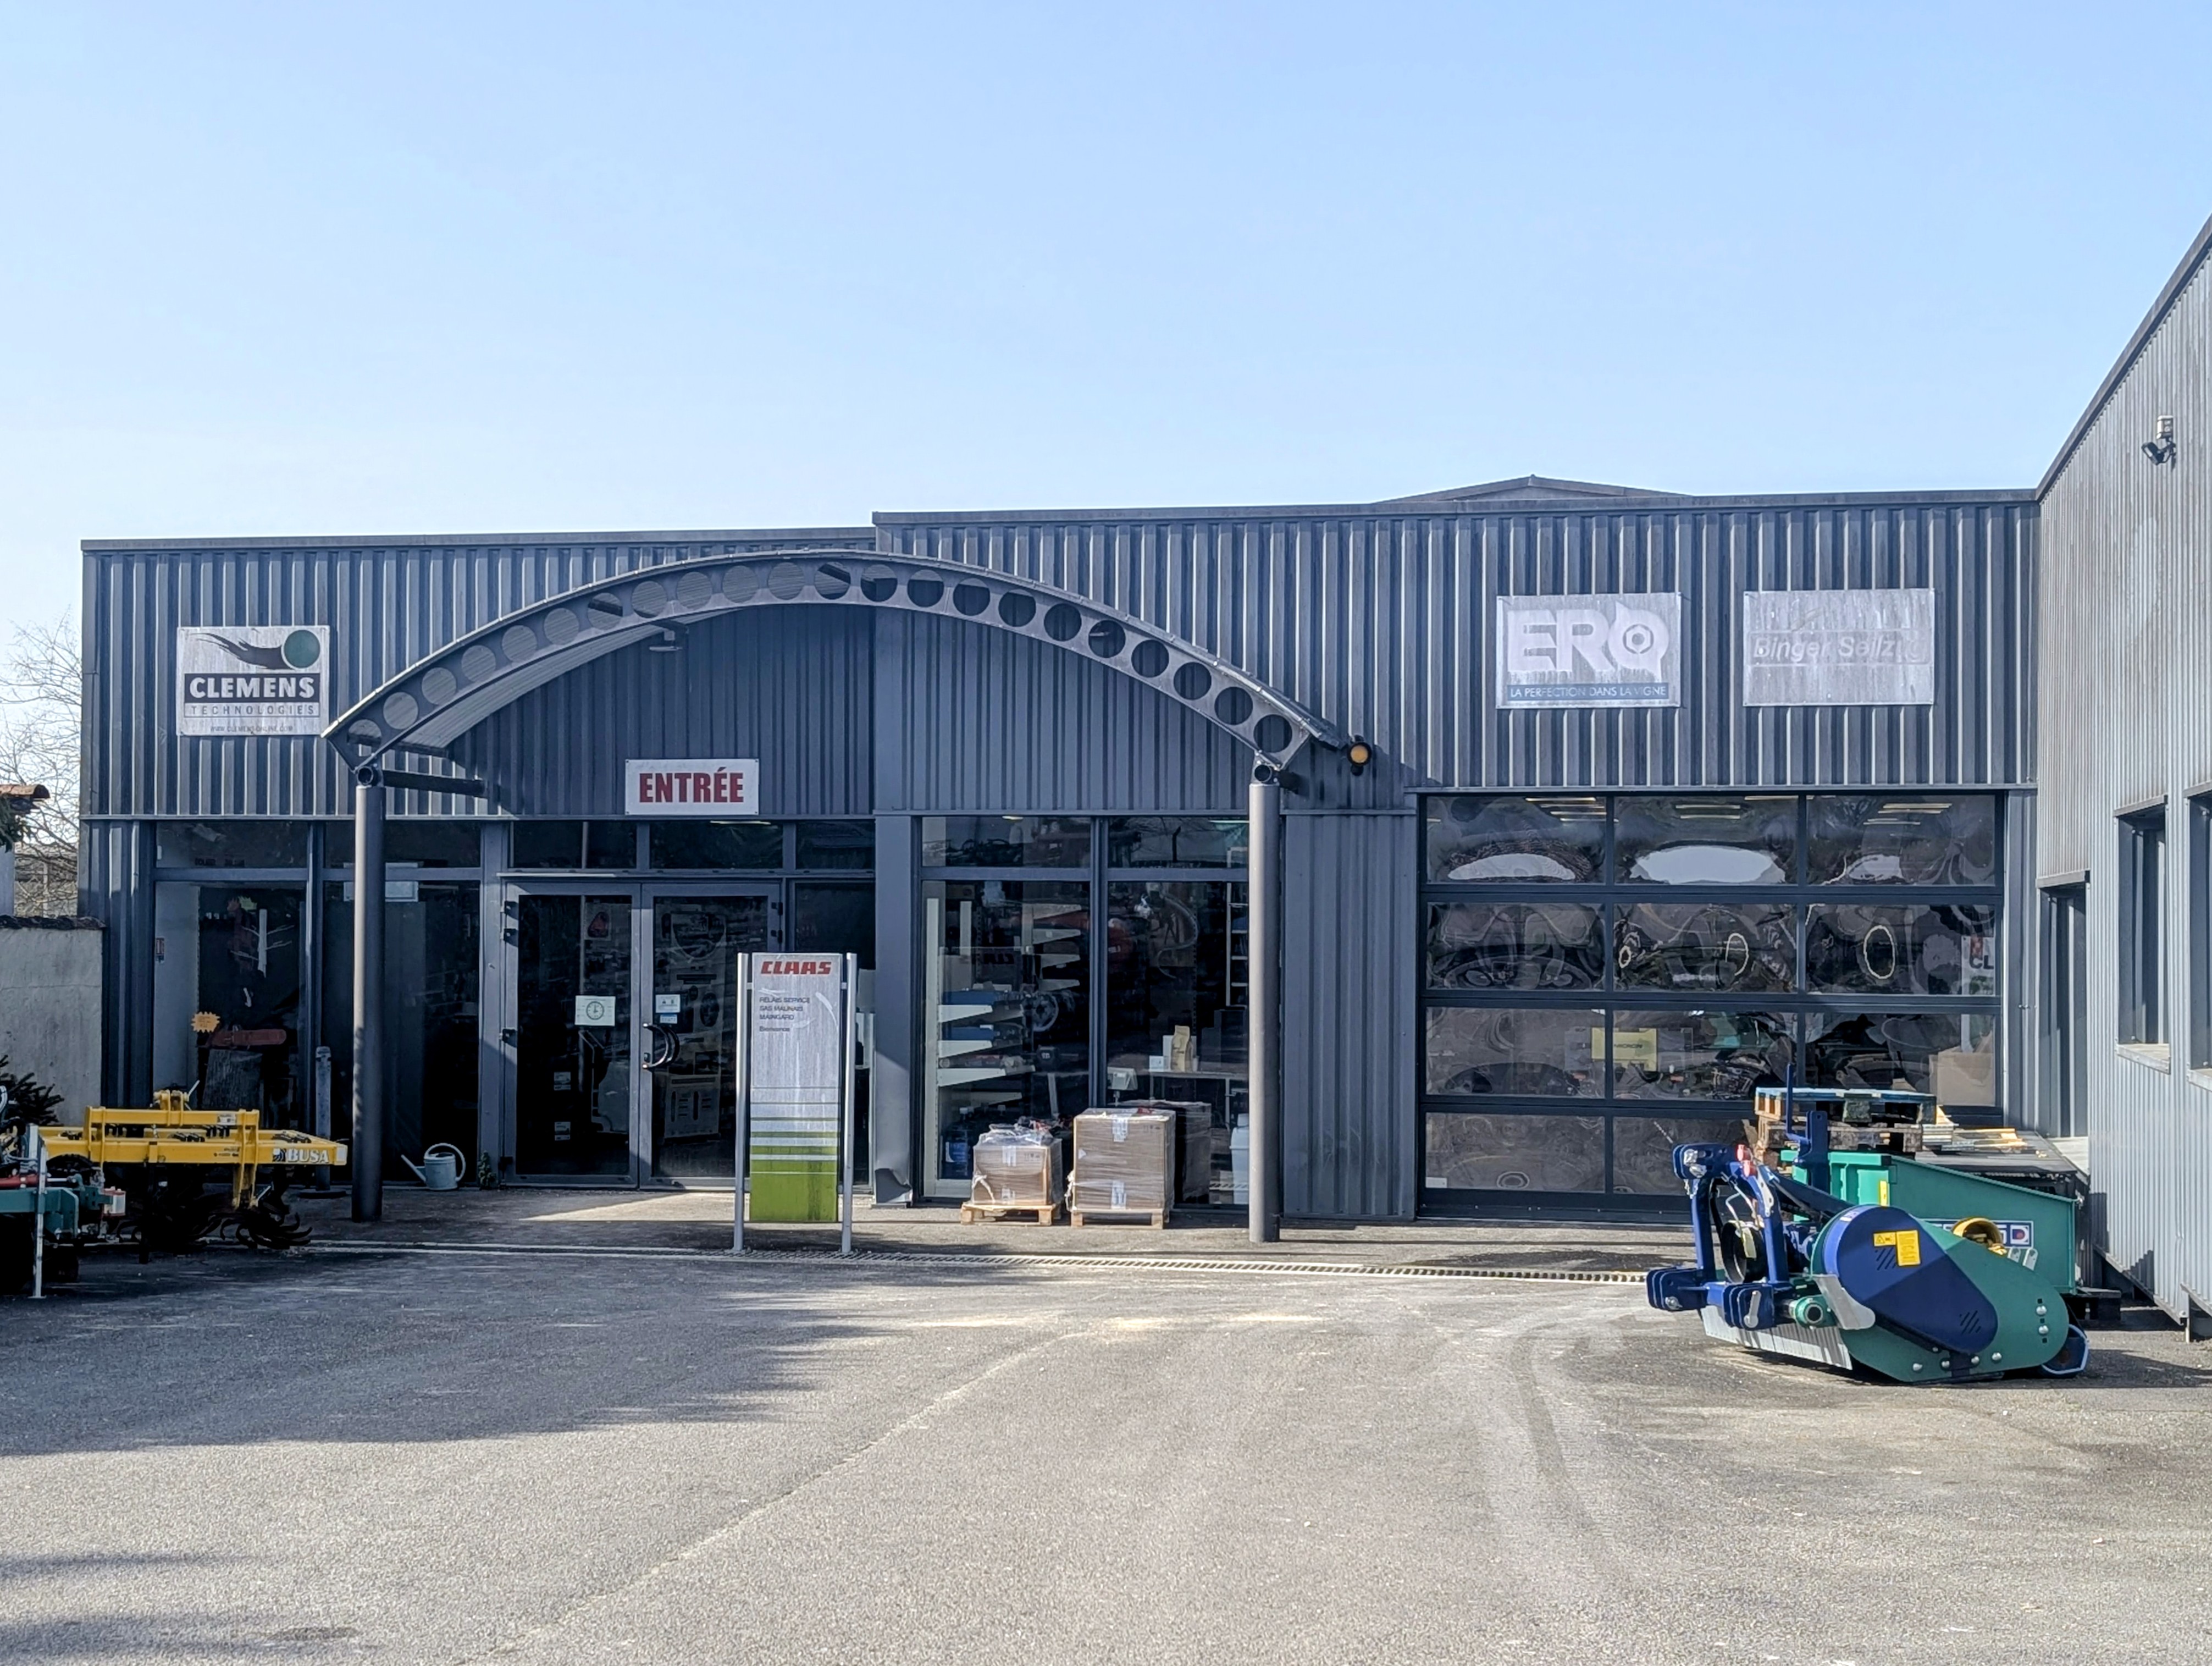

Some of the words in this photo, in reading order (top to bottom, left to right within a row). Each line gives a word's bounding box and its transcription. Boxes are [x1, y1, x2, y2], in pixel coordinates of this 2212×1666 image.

[1507, 602, 1669, 683] ERO
[1754, 635, 1829, 663] Binger
[190, 677, 315, 698] CLEMENS
[1510, 687, 1522, 698] LA
[1524, 687, 1586, 698] PERFECTION
[1589, 686, 1617, 697] DANS
[1619, 686, 1632, 697] LA
[1634, 686, 1666, 697] VIGNE
[192, 705, 314, 715] TECHNOLOGIES
[639, 766, 744, 803] ENTRÉE
[760, 961, 832, 975] CLAAS
[287, 1148, 329, 1164] BUSA
